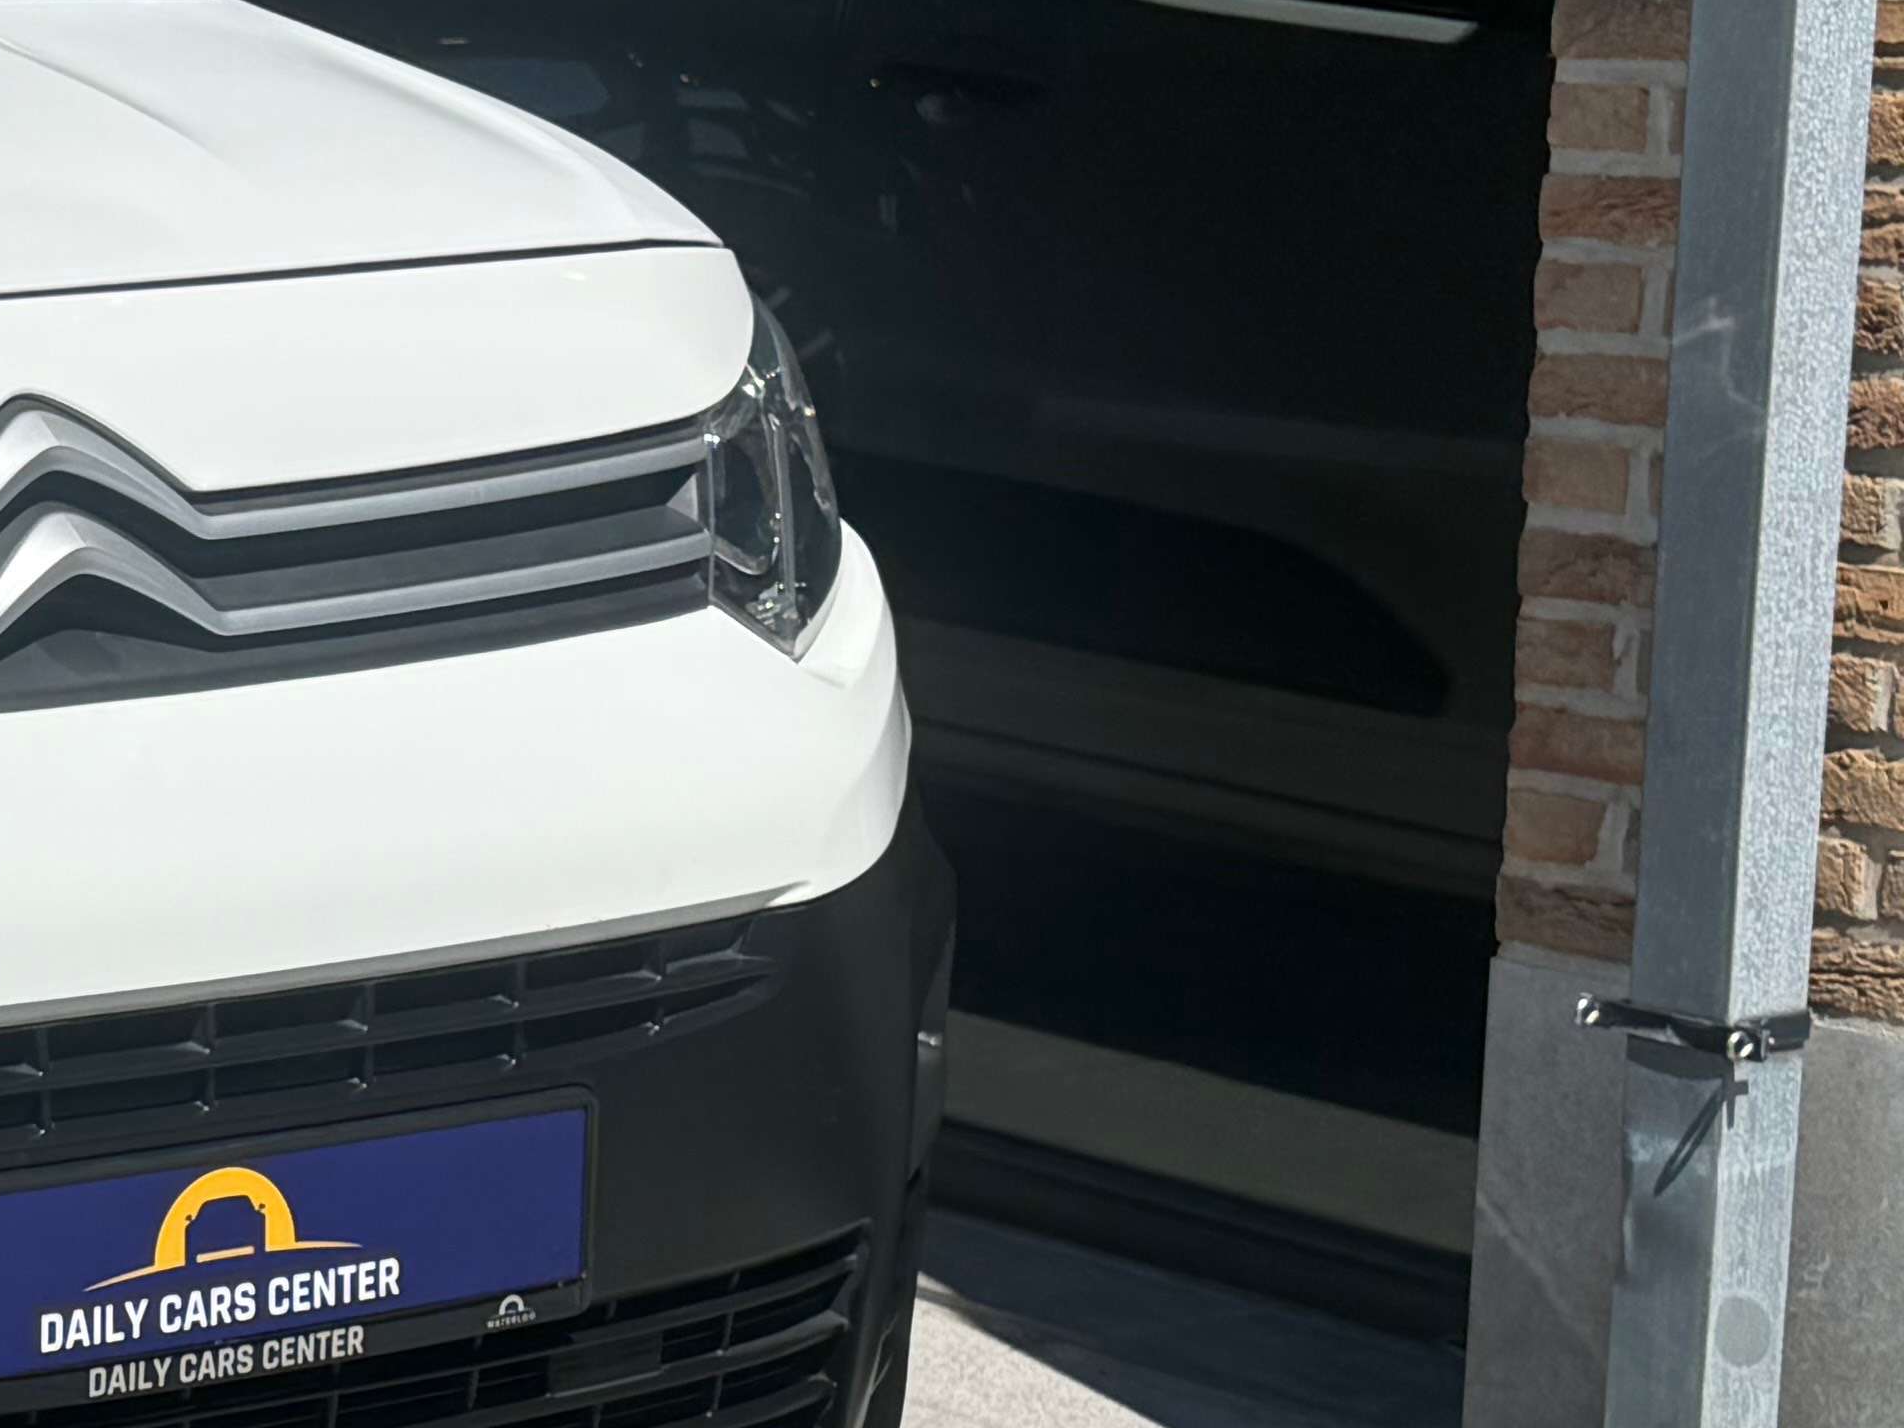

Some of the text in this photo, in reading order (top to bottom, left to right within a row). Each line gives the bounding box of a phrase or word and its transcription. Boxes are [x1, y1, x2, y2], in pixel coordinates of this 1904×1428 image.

[40, 1257, 400, 1354] DAILY CARS CENTER
[88, 1325, 365, 1399] DAILY CARS CENTER
